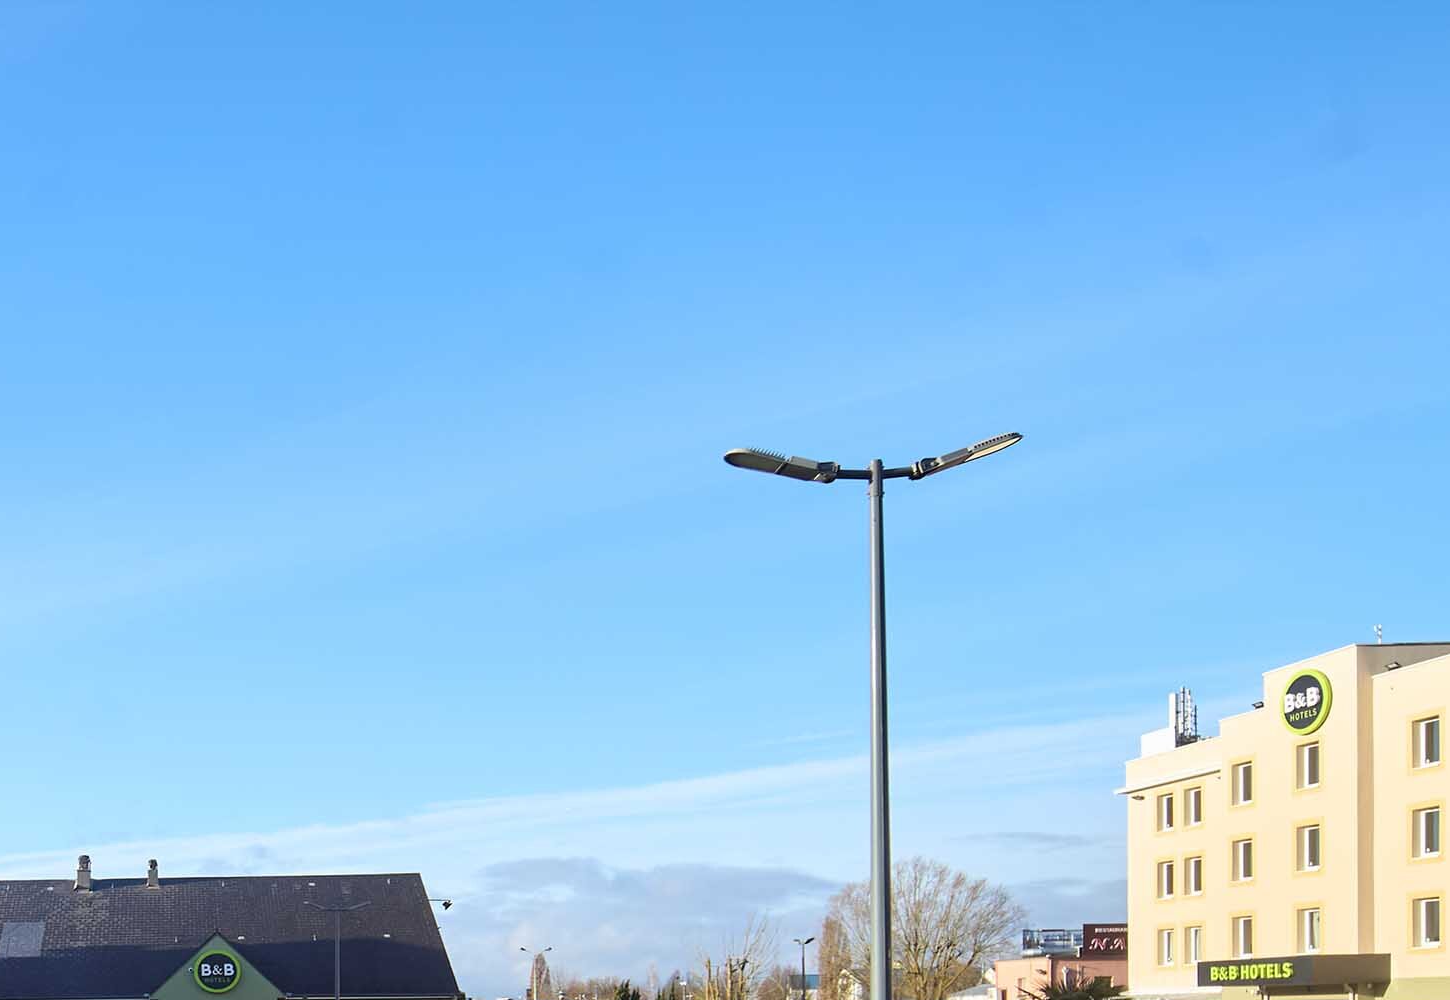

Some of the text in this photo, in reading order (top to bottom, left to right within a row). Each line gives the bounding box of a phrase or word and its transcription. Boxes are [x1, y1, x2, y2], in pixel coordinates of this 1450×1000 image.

[1284, 686, 1320, 714] B&B
[1289, 707, 1318, 722] HOTELS
[201, 963, 235, 977] B&B
[1210, 962, 1294, 981] B&B HOTELS
